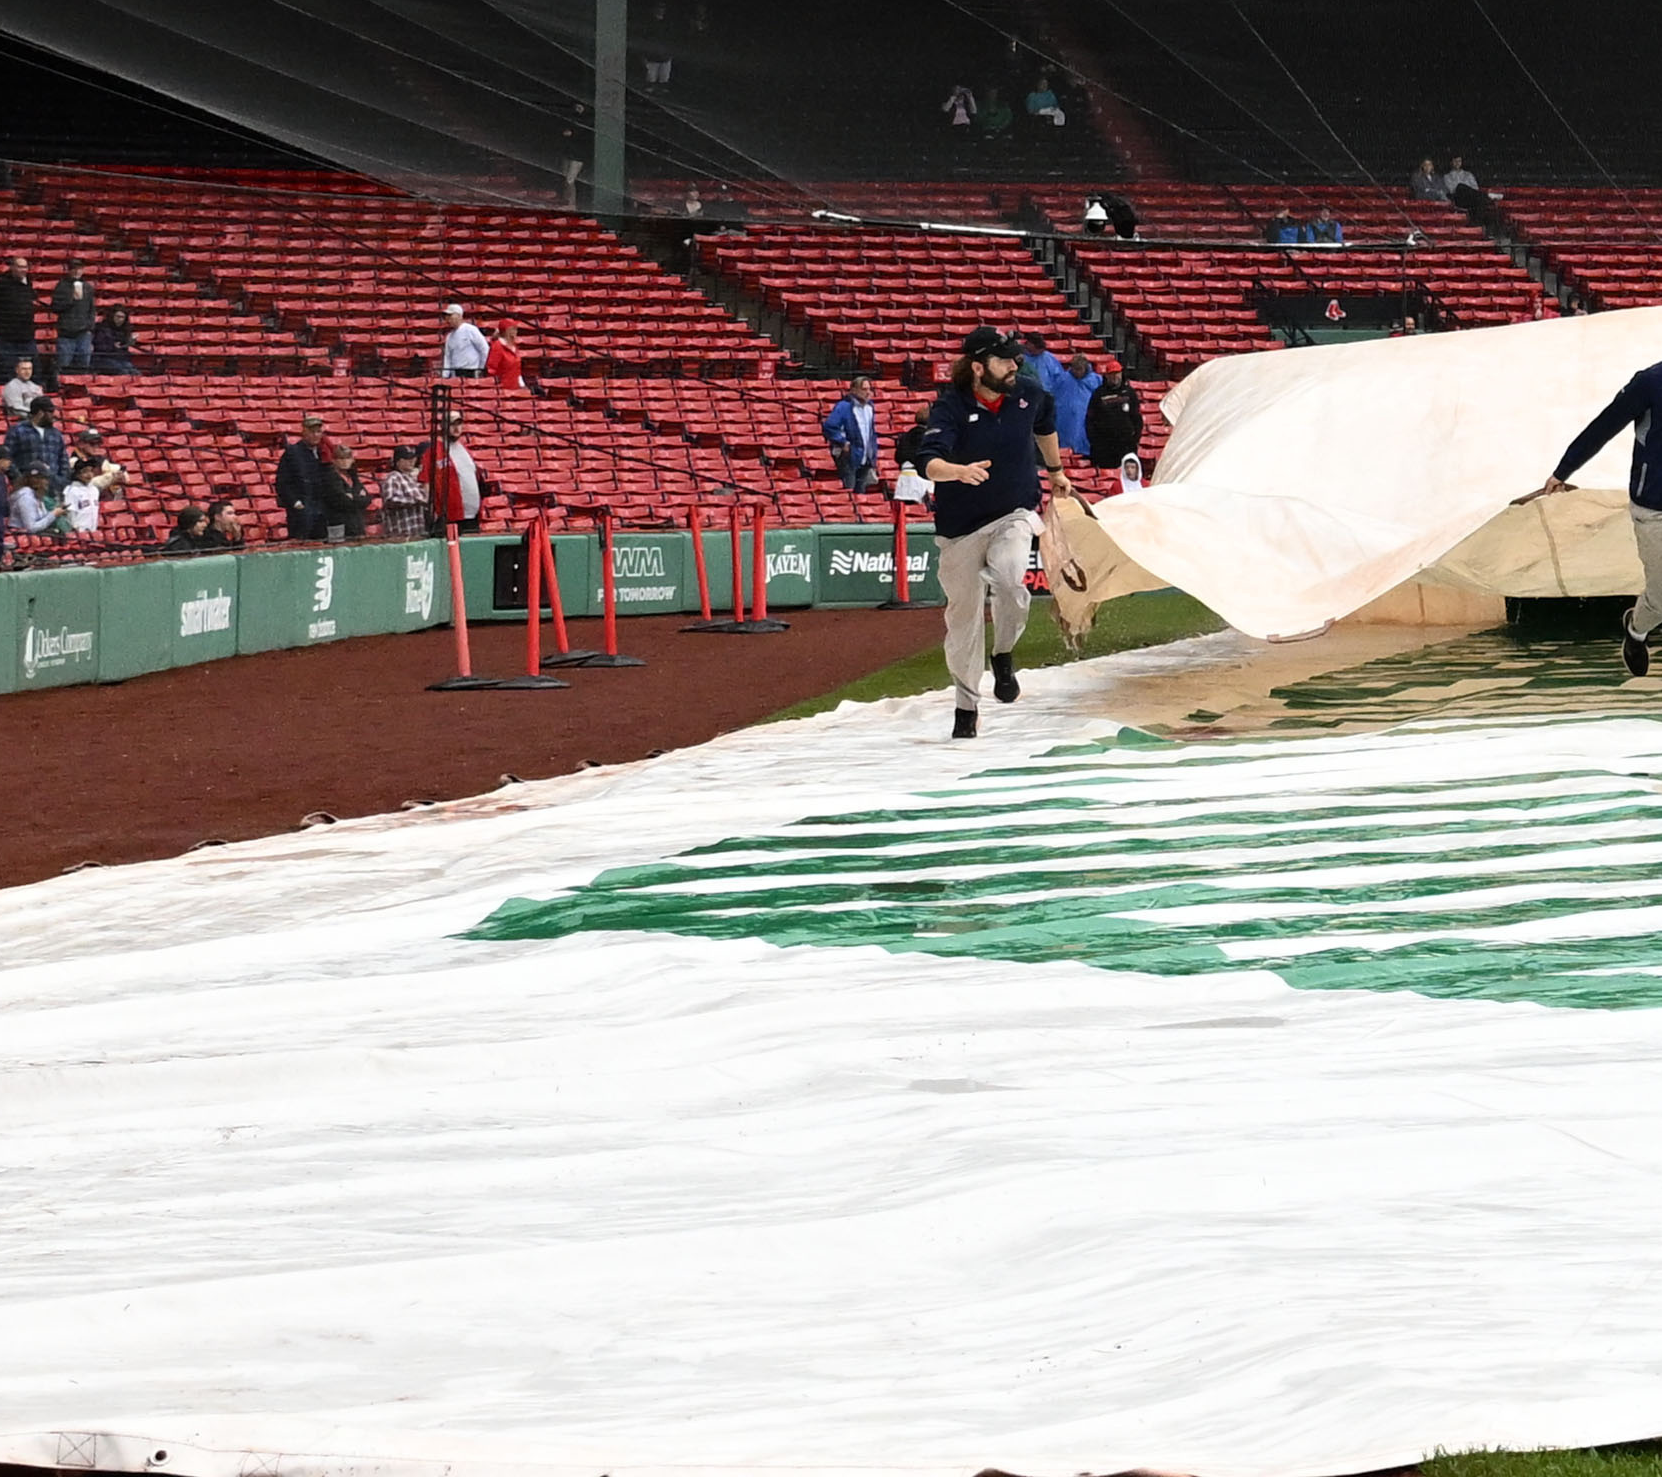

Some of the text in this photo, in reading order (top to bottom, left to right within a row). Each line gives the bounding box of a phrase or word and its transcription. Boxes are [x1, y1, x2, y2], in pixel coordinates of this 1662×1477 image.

[611, 547, 665, 577] WM
[765, 552, 811, 584] KAYEM
[618, 586, 676, 602] TOMORROW
